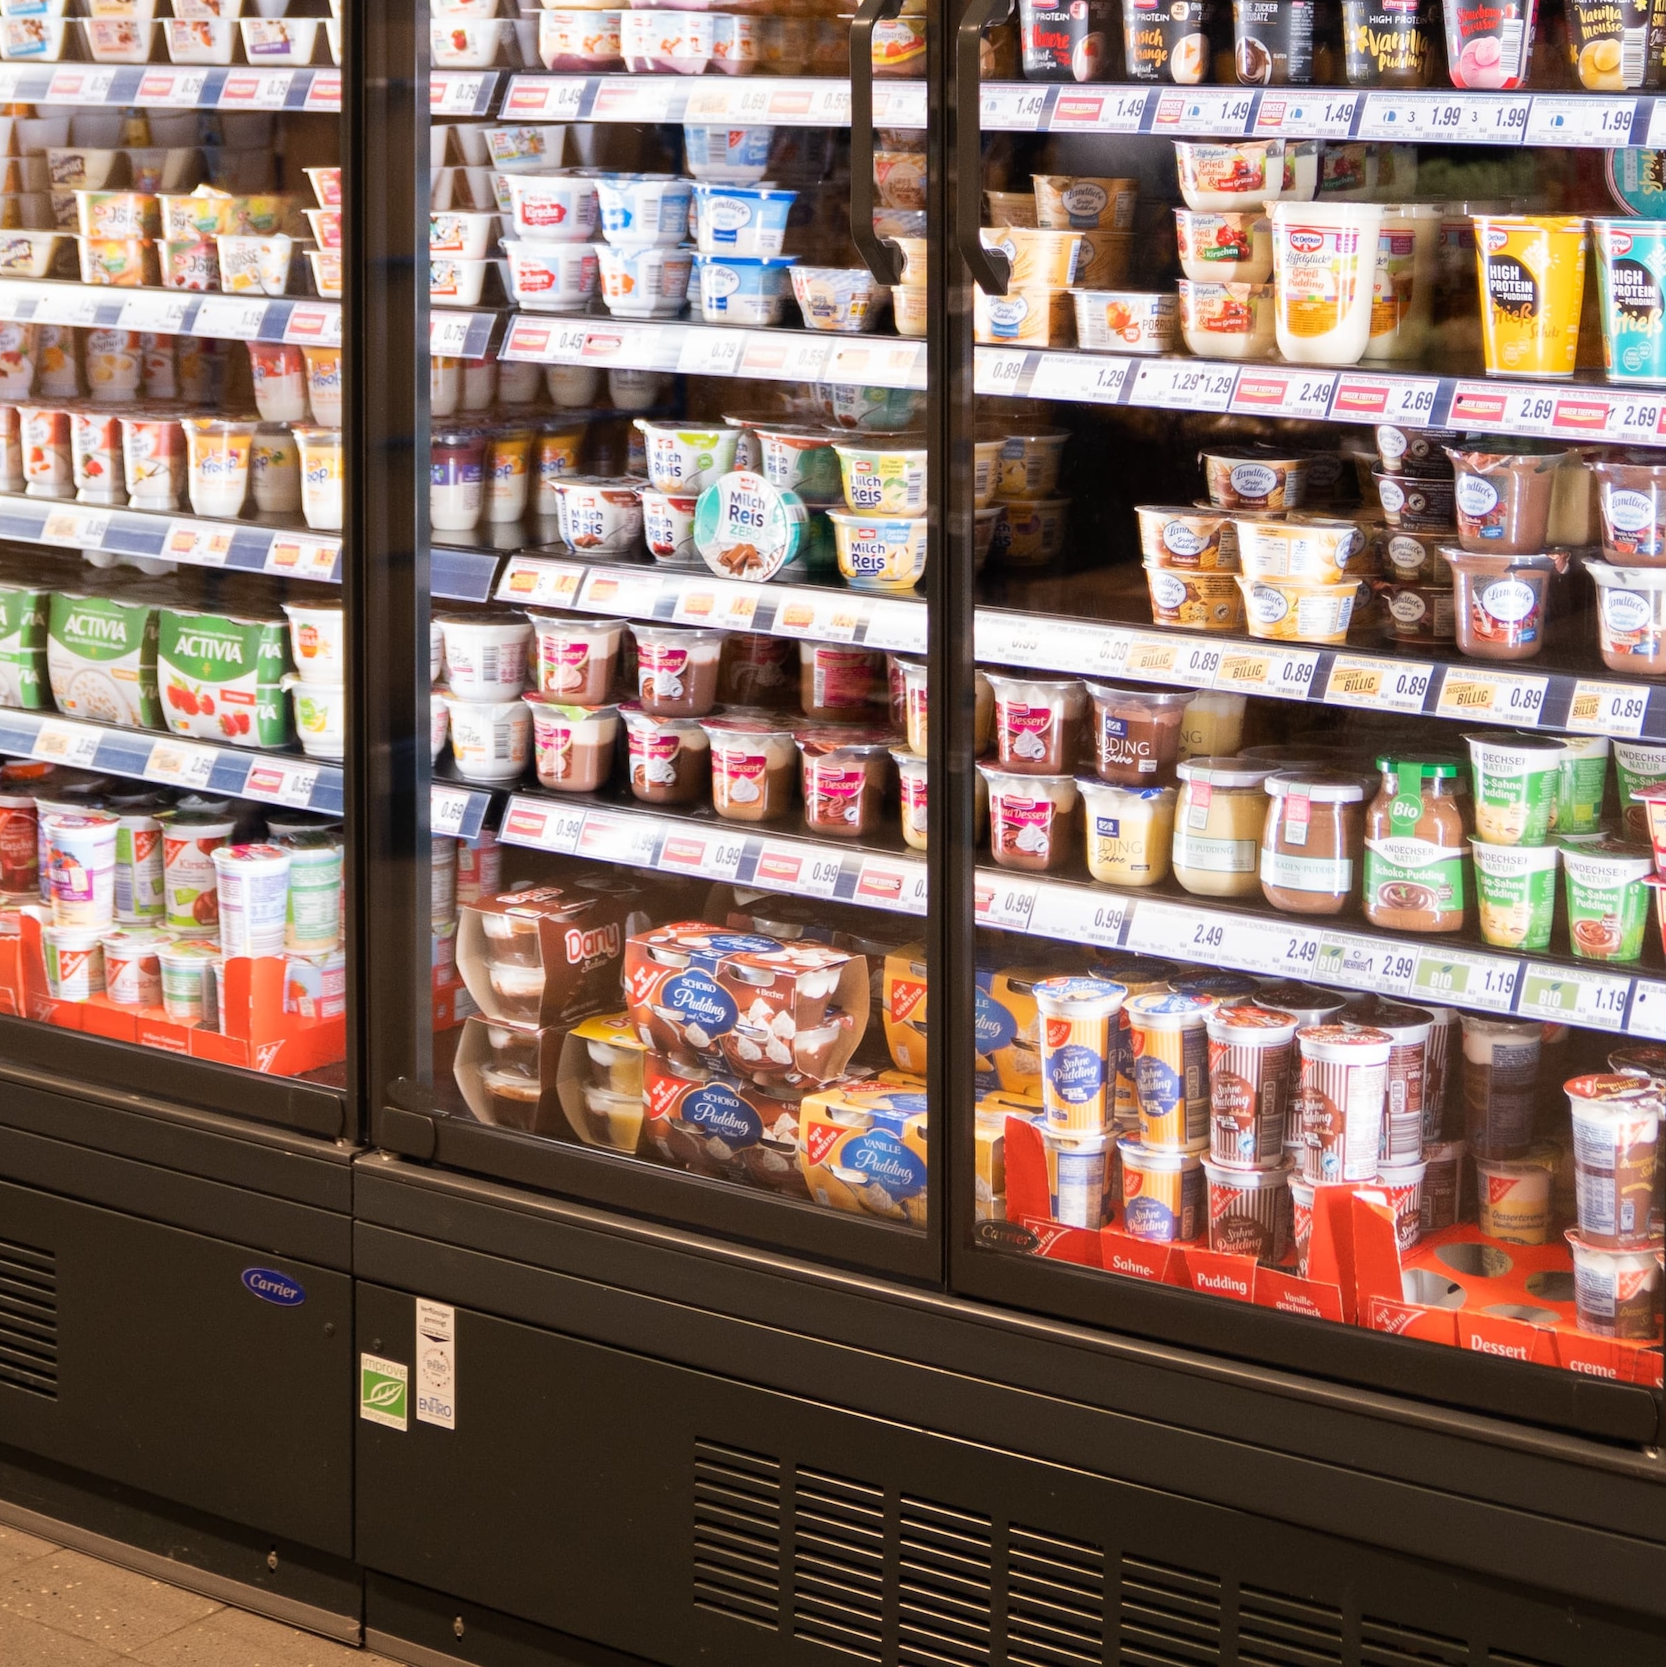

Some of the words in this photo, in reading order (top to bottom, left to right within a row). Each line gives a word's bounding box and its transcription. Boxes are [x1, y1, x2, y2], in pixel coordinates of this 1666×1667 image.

[1254, 2, 1279, 12] ZUCKER
[1016, 98, 1043, 115] 1.49
[1117, 99, 1143, 117] 1.49
[1222, 101, 1249, 120] 1.49
[1324, 104, 1353, 123] 1.49
[1432, 106, 1461, 126] 1.99
[1496, 108, 1525, 127] 1.99
[1602, 111, 1632, 131] 1.99
[1206, 247, 1238, 258] Kirschen
[1489, 265, 1519, 280] HIGH
[1612, 269, 1642, 285] HIGH
[1490, 280, 1533, 293] PROTEIN
[1612, 285, 1656, 297] PROTEIN
[1097, 366, 1126, 389] 1.29
[1171, 372, 1198, 390] 1.29
[1205, 376, 1232, 394] 1.29
[1300, 383, 1331, 403] 2.49
[1401, 389, 1433, 413] 2.69
[1521, 398, 1552, 419] 2.69
[1624, 405, 1657, 427] 2.69
[731, 490, 766, 512] Milch
[729, 506, 764, 527] Reis
[63, 618, 128, 643] ACTIVIA
[174, 636, 244, 665] ACTIVIA
[1190, 650, 1219, 671] 0.89
[1283, 662, 1313, 683] 0.89
[1396, 674, 1427, 696] 0.89
[1446, 685, 1475, 694] DISCOUNT
[1457, 690, 1488, 705] BILLIG
[1511, 687, 1541, 709] 0.89
[1611, 698, 1643, 718] 0.89
[1392, 802, 1419, 818] Bio
[716, 846, 740, 866] 0.99
[1383, 844, 1434, 857] ANDECHSER
[1393, 853, 1421, 864] NATUR
[1375, 864, 1446, 881] Schoko-Pudding
[1005, 892, 1033, 914] 0.99
[1572, 887, 1618, 901] Bio-Sahne
[1094, 907, 1122, 929] 0.99
[565, 920, 620, 965] Dany
[1194, 924, 1223, 947] 2.49
[1287, 938, 1317, 962] 2.49
[1318, 955, 1341, 971] BIO
[1382, 955, 1413, 978] 2.99
[681, 978, 716, 994] SCHOKO
[1484, 970, 1515, 993] 1.19
[673, 987, 727, 1022] Pudding
[761, 989, 785, 1000] Becher
[1595, 987, 1626, 1011] 1.19
[1062, 1057, 1090, 1070] Sahne
[703, 1092, 739, 1108] SCHOKO
[695, 1103, 750, 1136] Pudding
[864, 1138, 901, 1155] VANILLE
[1113, 1254, 1155, 1277] Sahne-
[249, 1273, 298, 1300] Carrier
[1197, 1272, 1248, 1295] Pudding
[1283, 1292, 1316, 1307] Vanille-
[1276, 1302, 1321, 1318] geschmack
[1470, 1334, 1527, 1360] Dessert
[362, 1356, 407, 1378] improve
[1569, 1360, 1617, 1379] creme
